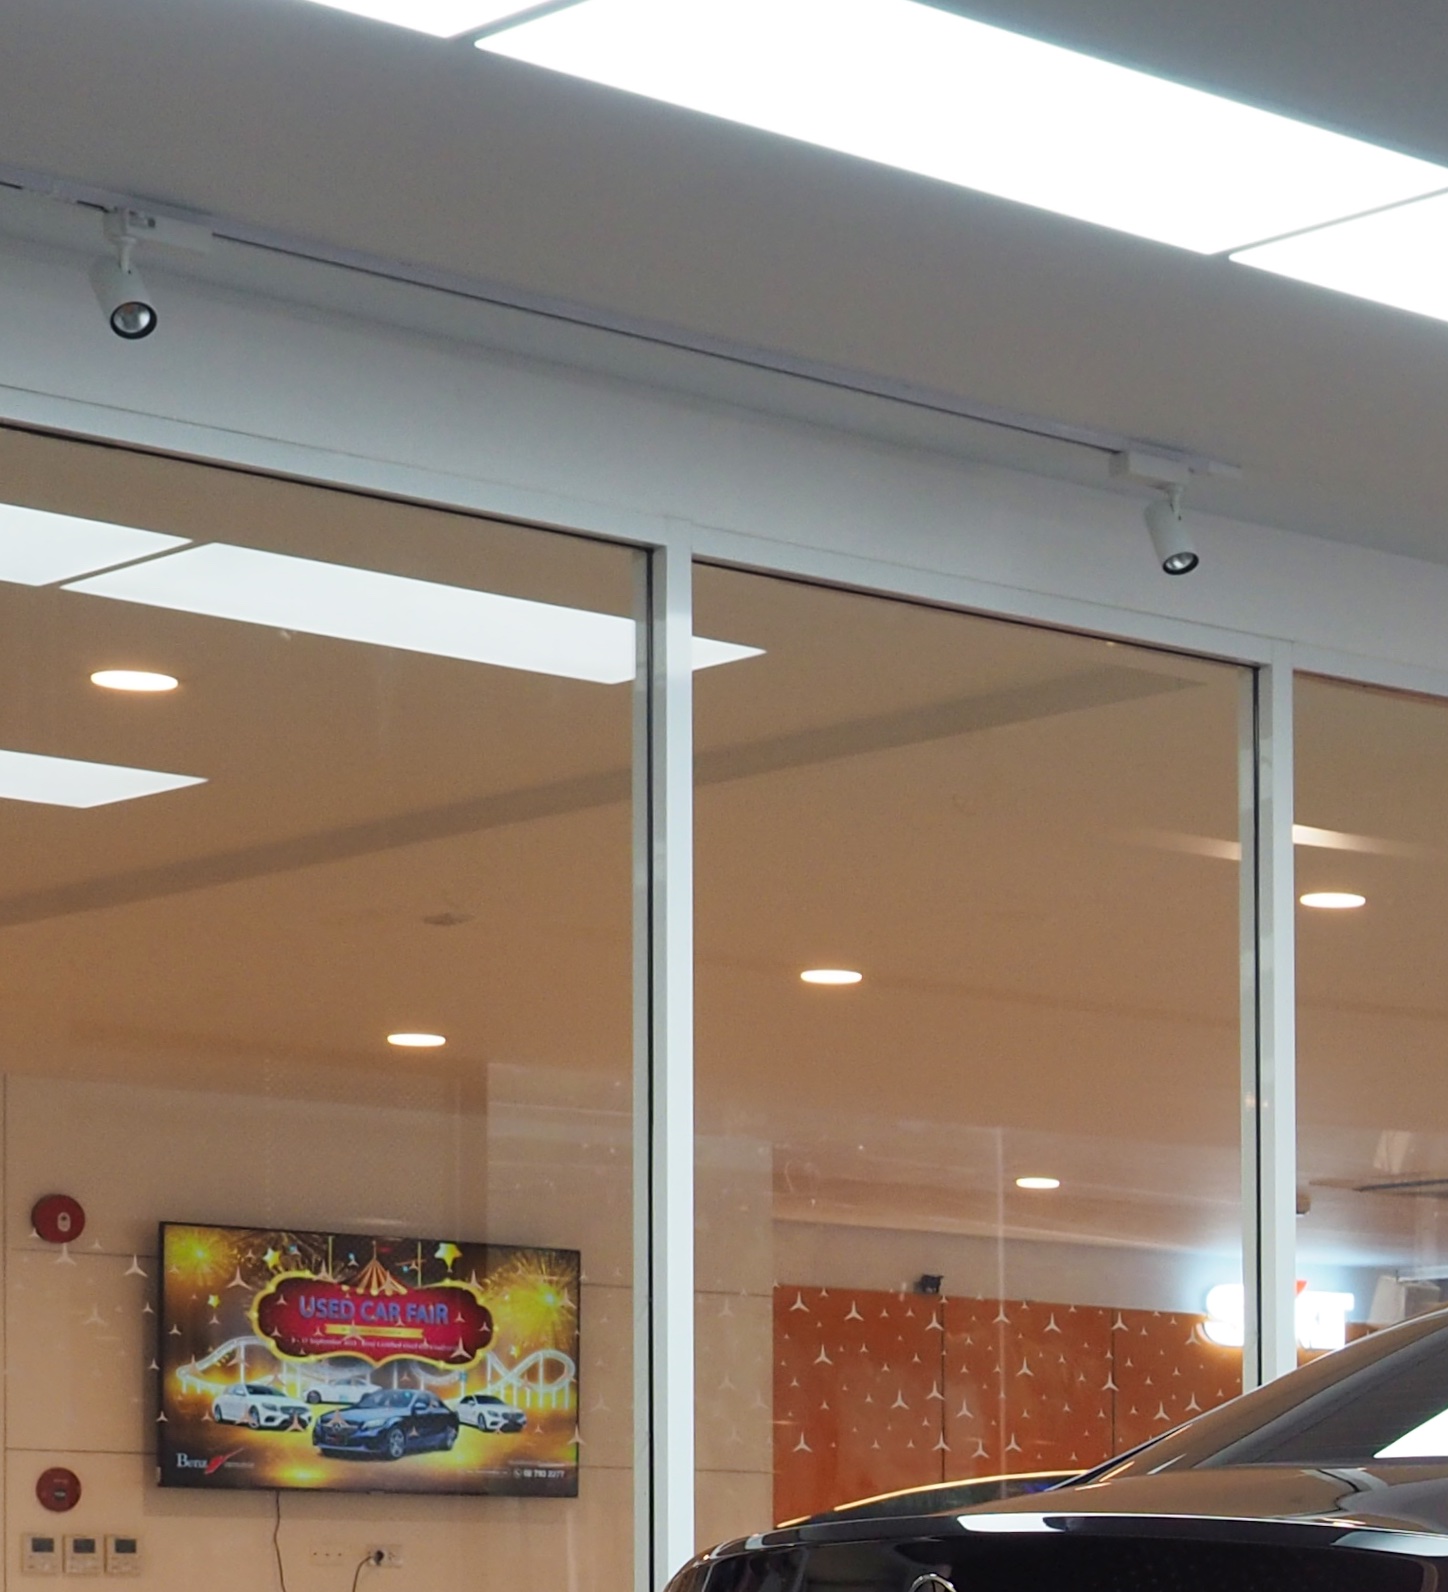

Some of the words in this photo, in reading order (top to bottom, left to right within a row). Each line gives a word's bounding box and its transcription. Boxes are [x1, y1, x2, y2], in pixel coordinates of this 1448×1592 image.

[298, 1295, 355, 1320] USED
[360, 1300, 402, 1322] CAR
[406, 1302, 449, 1325] FAIR
[176, 1452, 208, 1468] Benz
